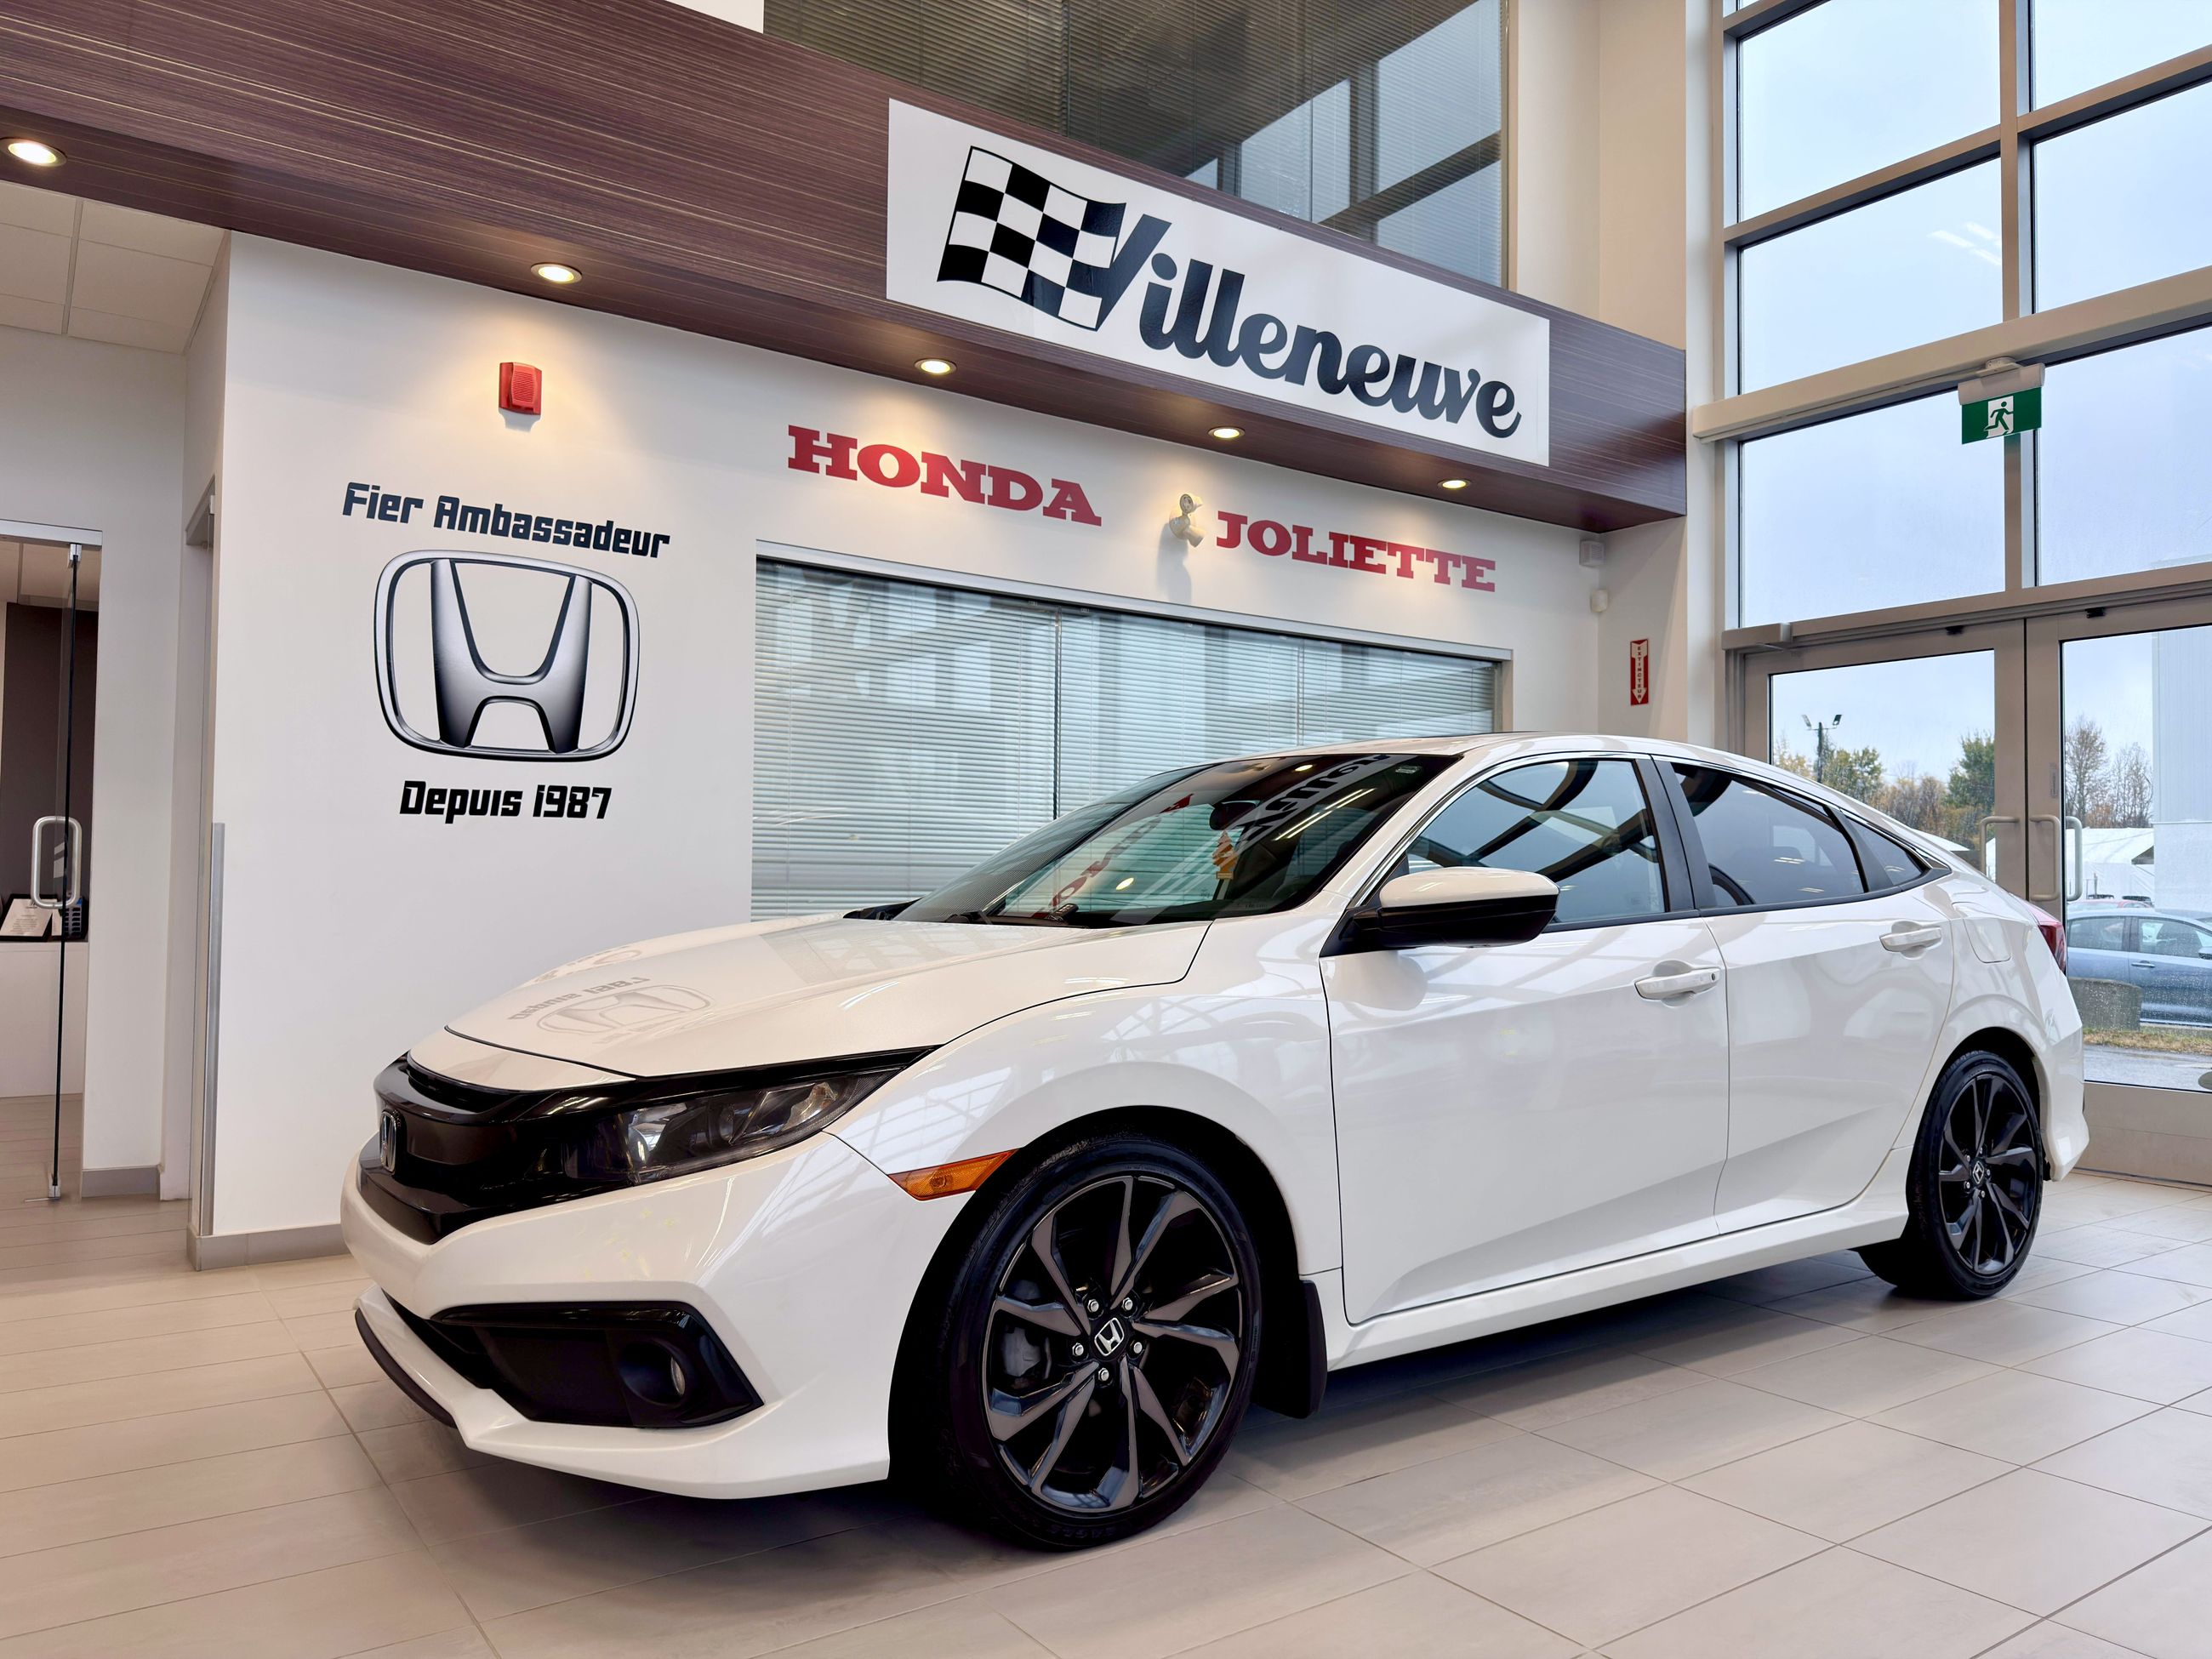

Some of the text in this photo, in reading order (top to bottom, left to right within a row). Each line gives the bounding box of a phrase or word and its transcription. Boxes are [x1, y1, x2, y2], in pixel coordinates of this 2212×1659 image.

[1092, 209, 1522, 439] Villeneuve
[342, 482, 670, 558] Fier Ambassadeur
[788, 425, 1496, 592] HONDA JOLIETTE
[400, 780, 612, 824] Depuis 1987
